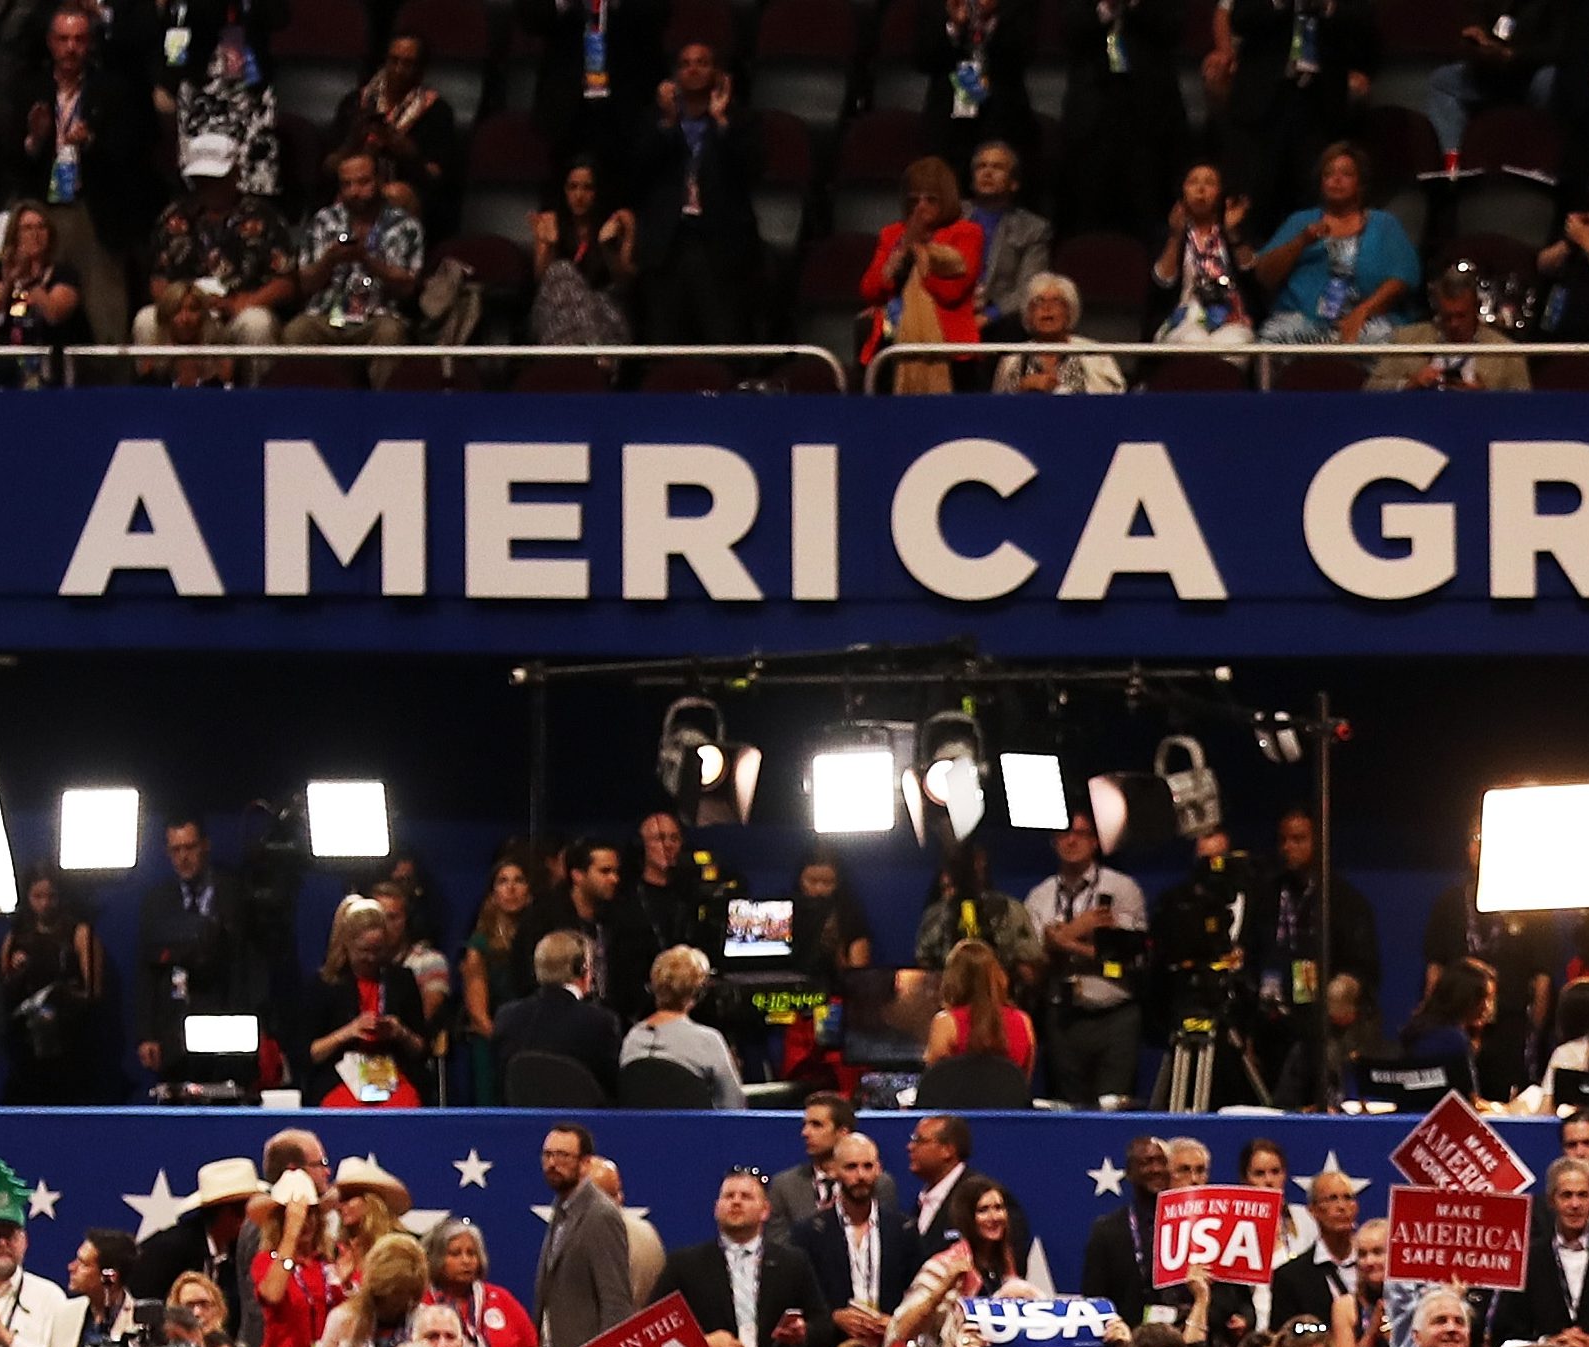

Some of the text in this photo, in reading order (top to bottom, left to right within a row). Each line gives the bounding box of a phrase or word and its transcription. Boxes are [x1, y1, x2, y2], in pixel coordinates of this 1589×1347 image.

[58, 439, 1228, 601] AMERICA
[1410, 1143, 1452, 1189] WORK
[1419, 1122, 1496, 1192] AMERIC
[1463, 1134, 1499, 1173] MAKE
[1163, 1198, 1272, 1221] MADE IN THE
[1436, 1202, 1482, 1220] MAKE
[1160, 1217, 1264, 1272] USA
[1391, 1221, 1523, 1252] AMERICA
[1401, 1246, 1512, 1271] SAFE AGAIN
[642, 1310, 685, 1342] THE
[973, 1300, 1106, 1344] USA
